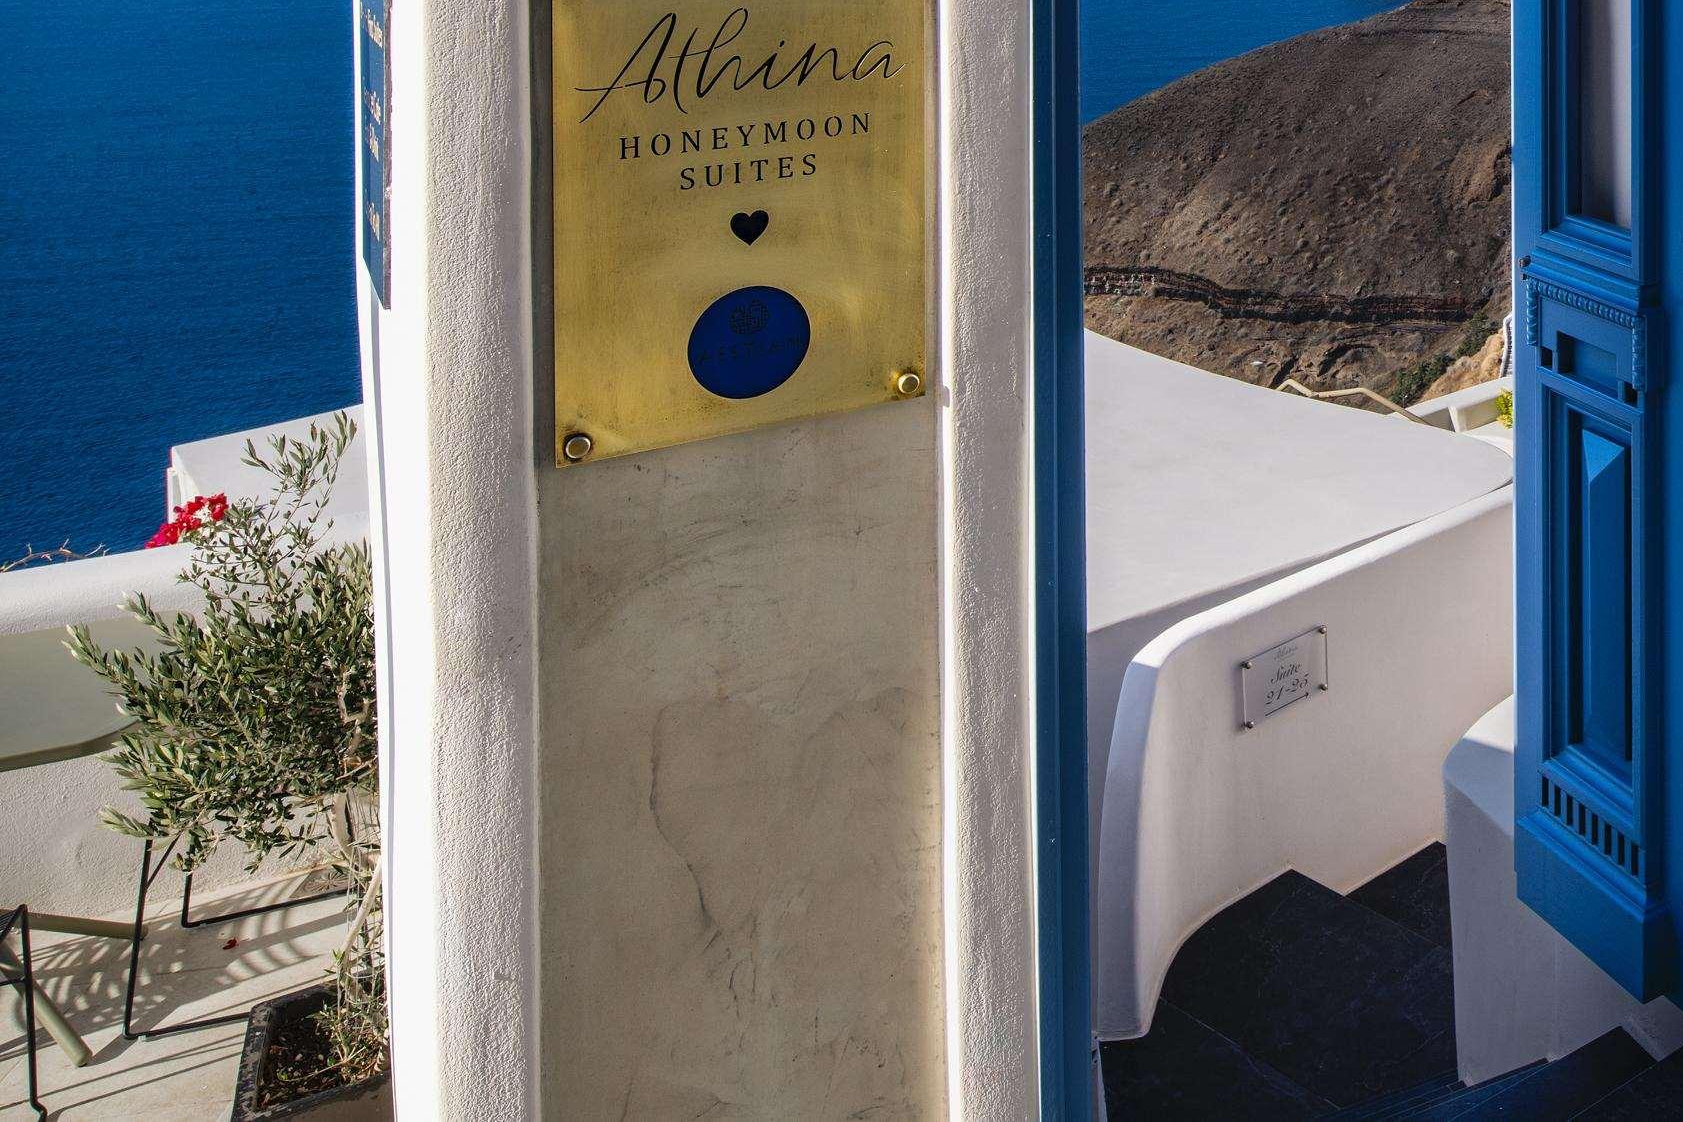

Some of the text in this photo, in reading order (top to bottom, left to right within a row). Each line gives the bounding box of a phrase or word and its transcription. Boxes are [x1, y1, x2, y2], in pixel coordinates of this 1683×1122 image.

[575, 7, 905, 124] Athina
[619, 112, 871, 160] HONEYMOON
[680, 154, 817, 190] SUITES
